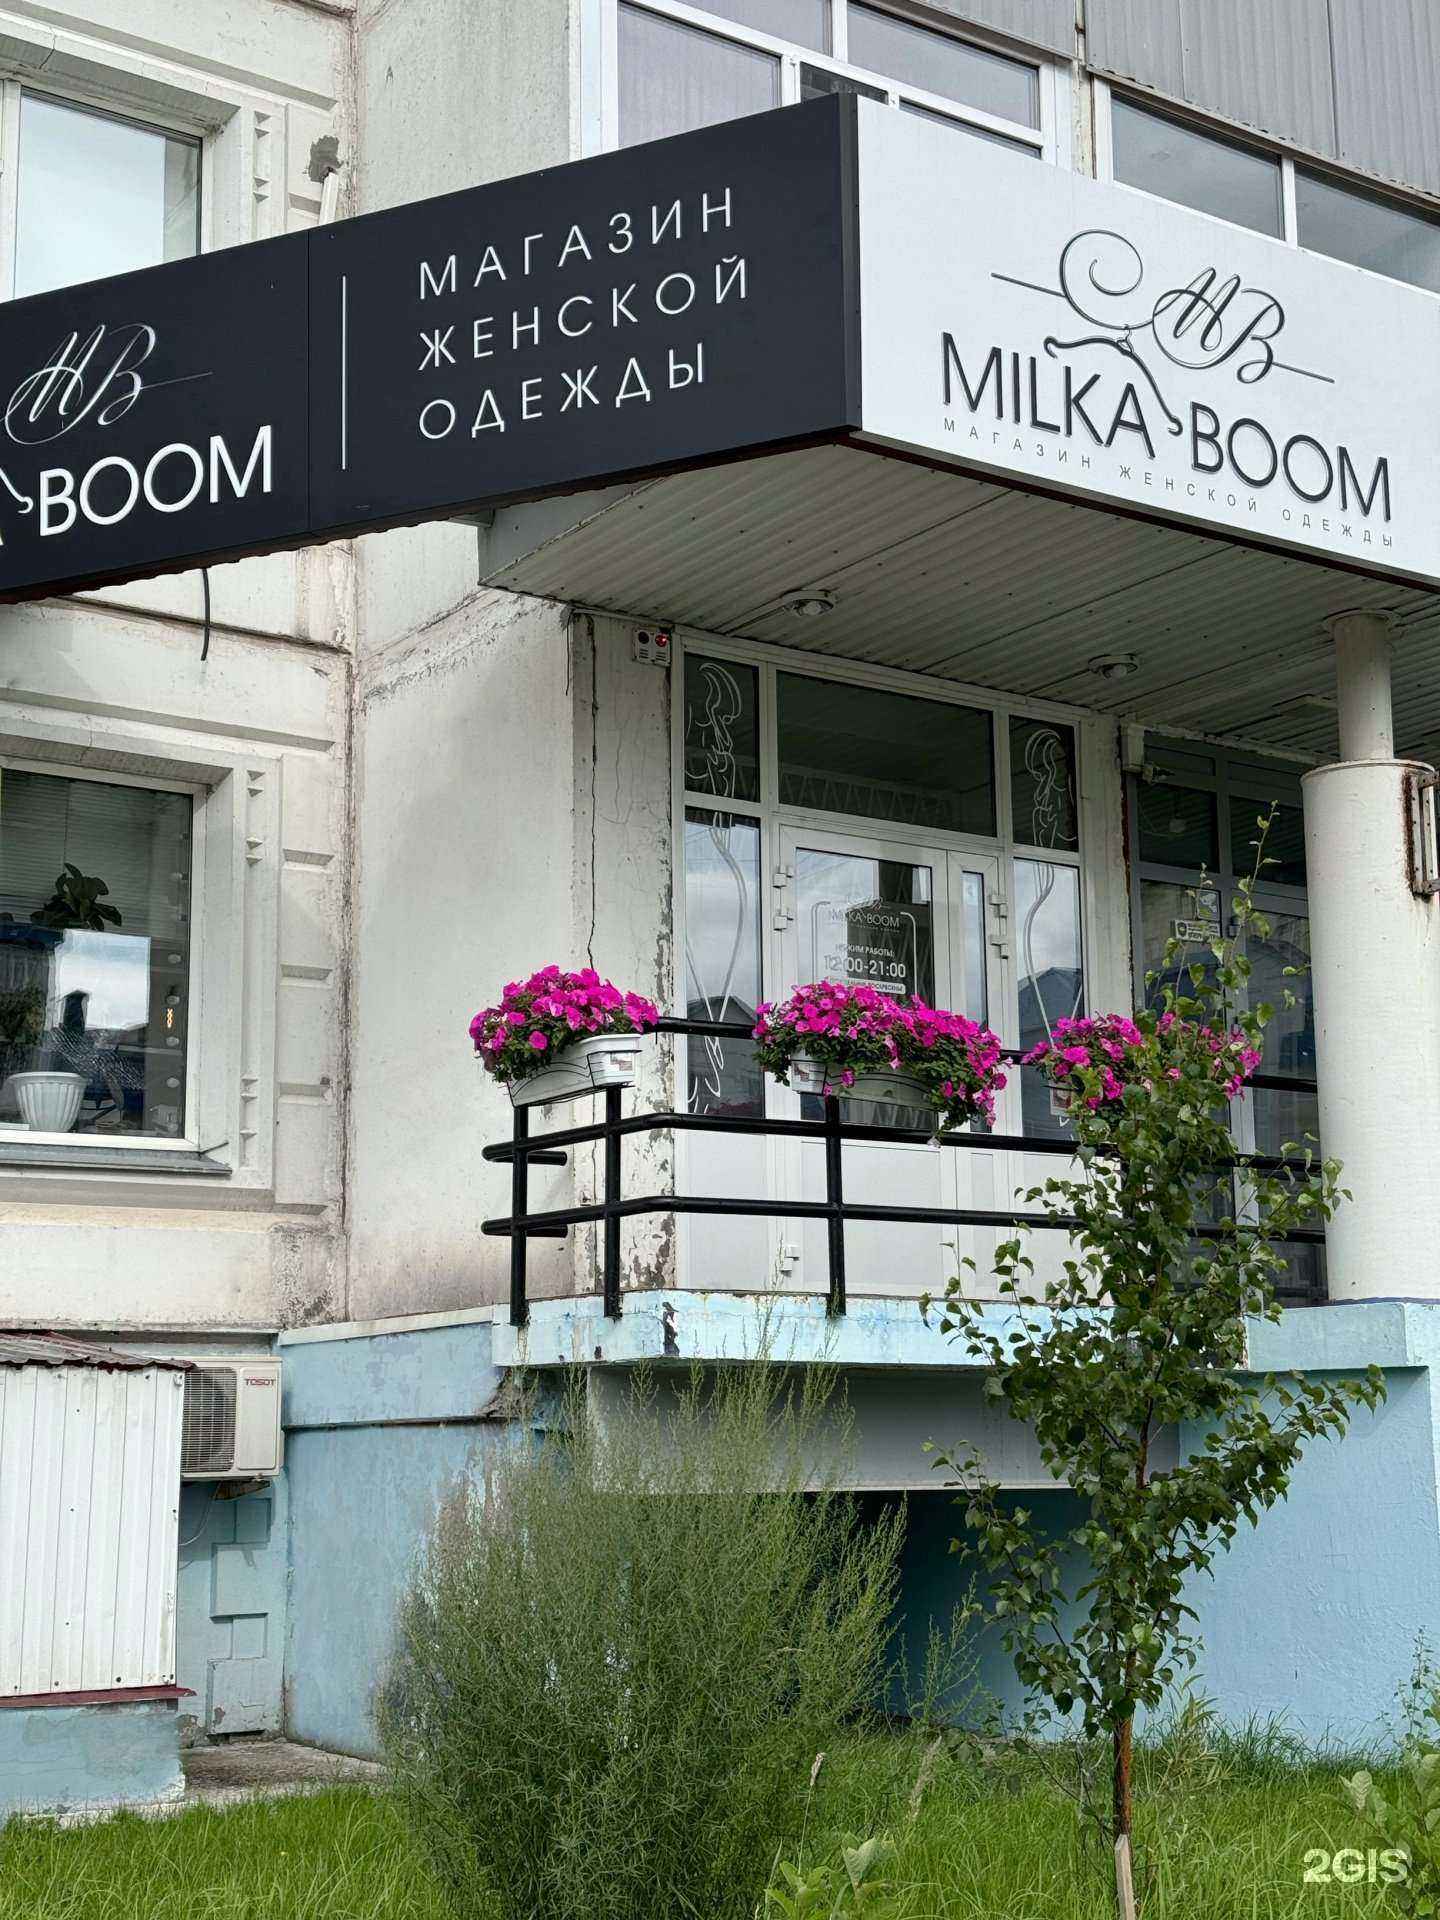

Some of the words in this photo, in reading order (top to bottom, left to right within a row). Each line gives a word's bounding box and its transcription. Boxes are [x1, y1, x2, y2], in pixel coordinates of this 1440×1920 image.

[419, 187, 733, 301] МАГАЗИН
[418, 256, 748, 372] ЖЕНСКОЙ
[418, 342, 705, 440] ОДЕЖДЫ
[941, 331, 1156, 459] MILKA
[1190, 401, 1392, 523] BOOM
[39, 424, 272, 537] BOOM
[943, 417, 1092, 470] МАГАЗИН
[1118, 464, 1258, 513] ЖЕНСКОЙ
[1282, 507, 1393, 547] ОДЕЖДЫ
[824, 954, 906, 978] 1200-21:00
[829, 906, 863, 923] MKA
[867, 912, 900, 928] BOOM
